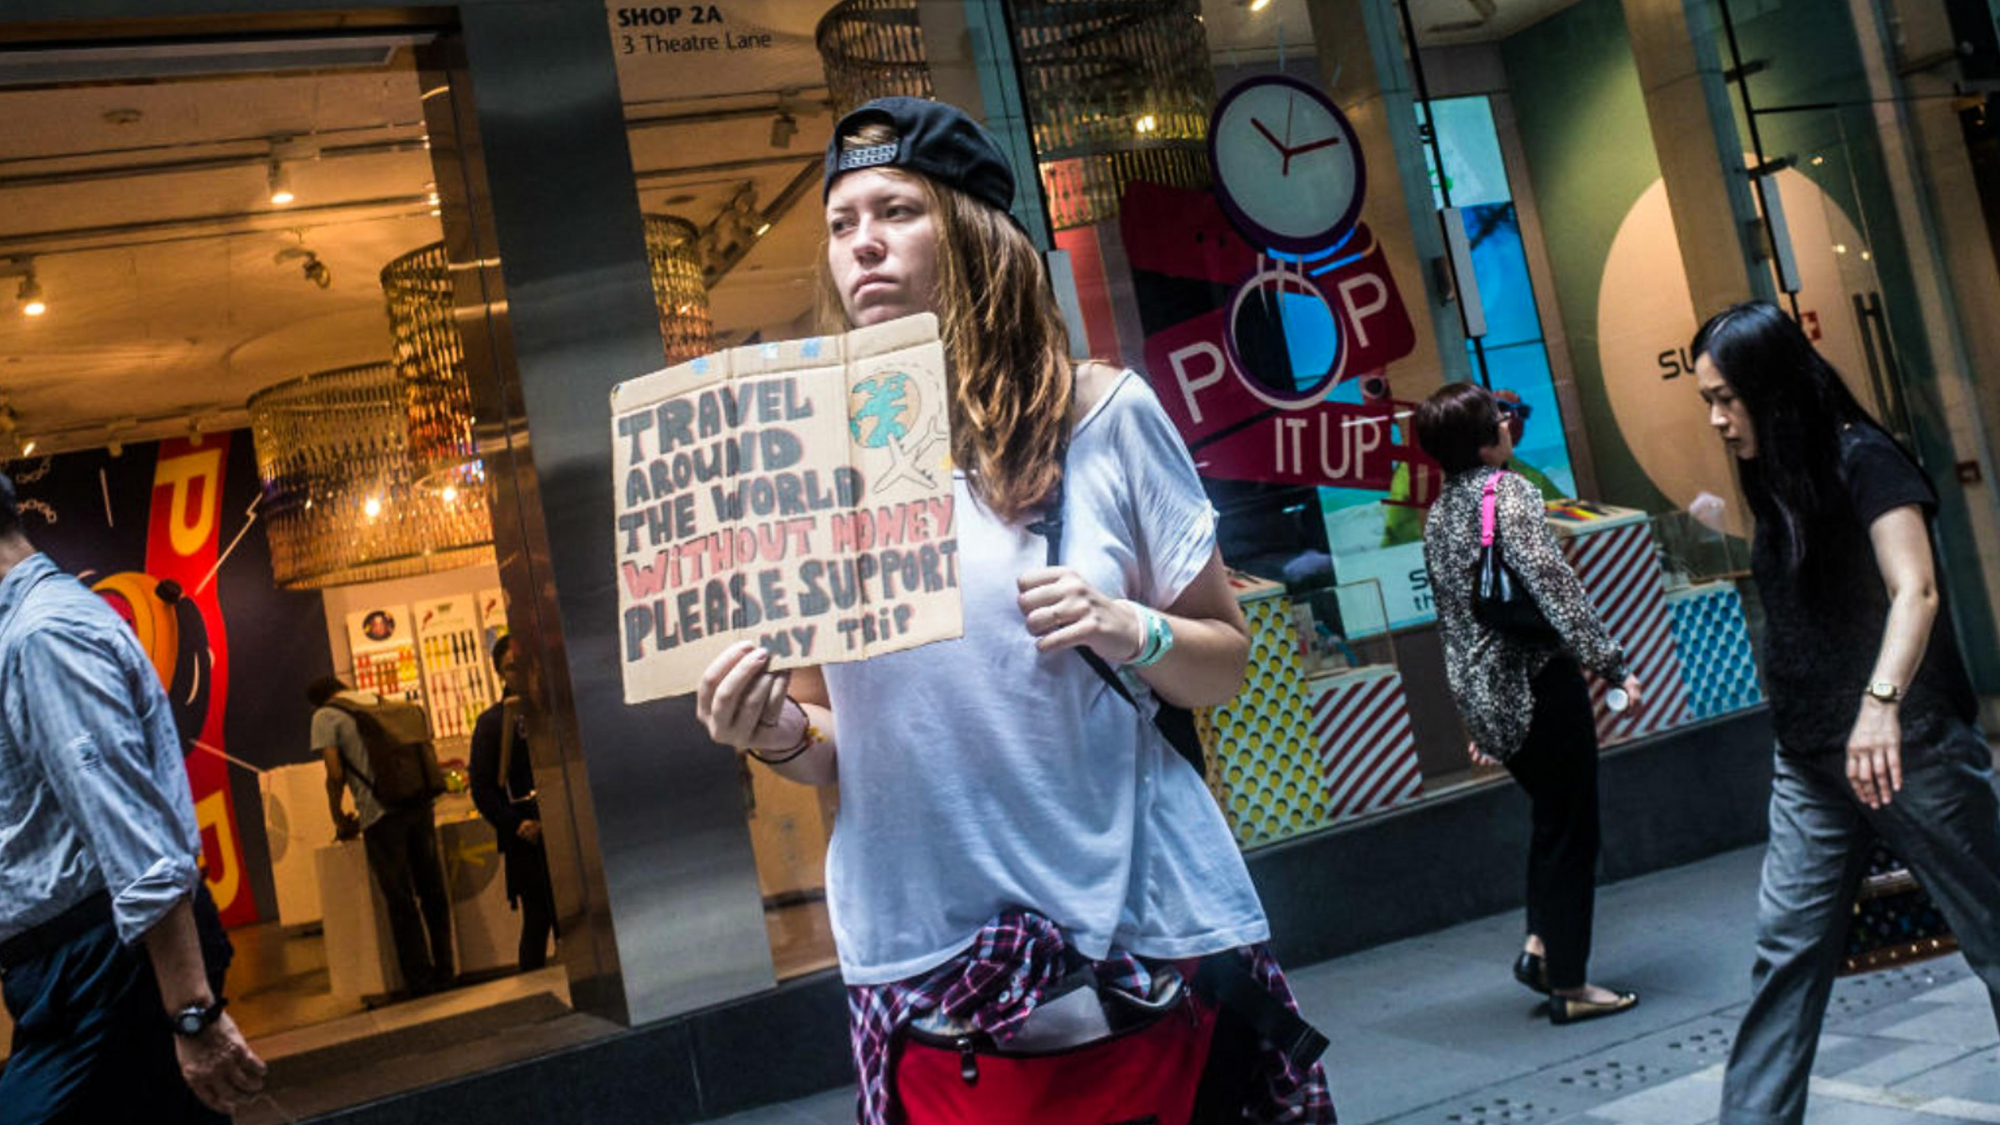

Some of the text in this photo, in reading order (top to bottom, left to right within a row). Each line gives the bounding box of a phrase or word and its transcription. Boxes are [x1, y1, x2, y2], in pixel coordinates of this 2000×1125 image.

[617, 5, 723, 27] SHOP 2A
[622, 31, 772, 54] 3 Theatre Lane
[617, 377, 814, 466] TRAVEL
[1274, 412, 1381, 480] IT UP
[625, 428, 804, 508] AROUND
[618, 467, 866, 554] THE WORLD
[623, 538, 958, 663] PLEASE SUPPORT
[760, 625, 816, 657] MY
